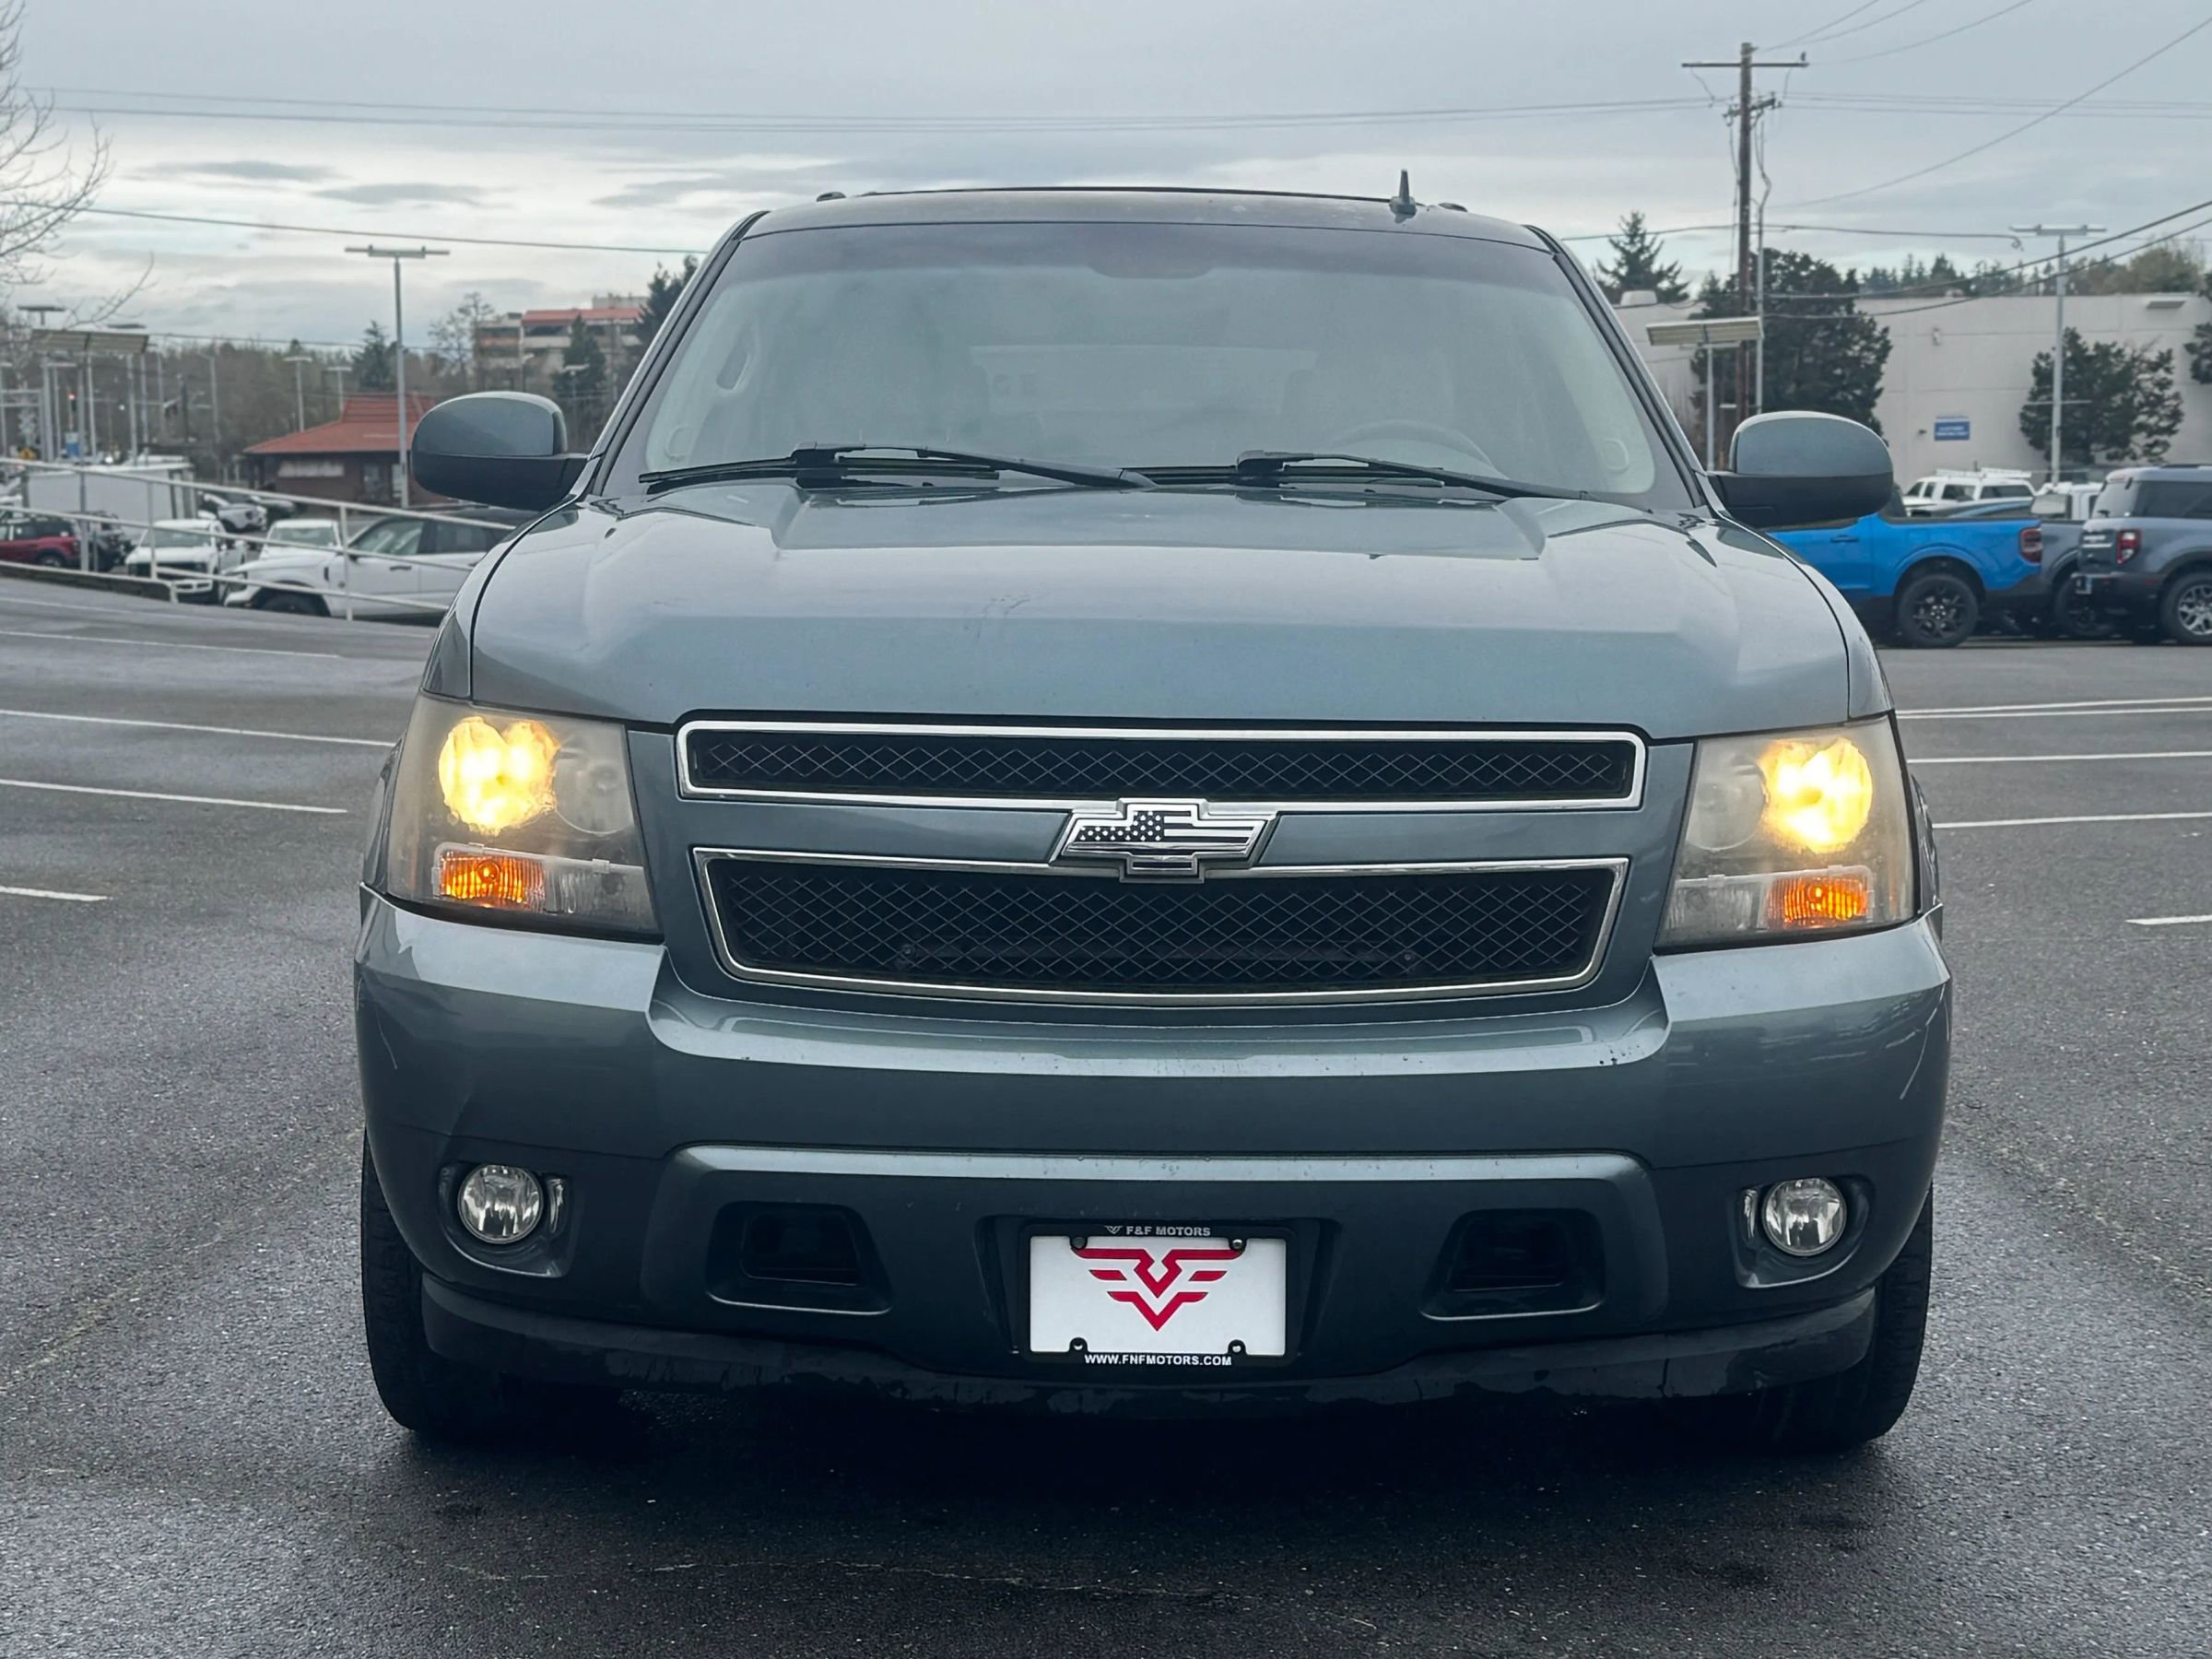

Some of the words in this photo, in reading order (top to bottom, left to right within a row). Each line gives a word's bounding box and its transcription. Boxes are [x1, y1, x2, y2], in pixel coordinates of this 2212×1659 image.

[1126, 1226, 1151, 1236] F&F
[1156, 1226, 1211, 1236] MOTORS
[1085, 1354, 1232, 1366] WWW.FNFMOTORS.COM
